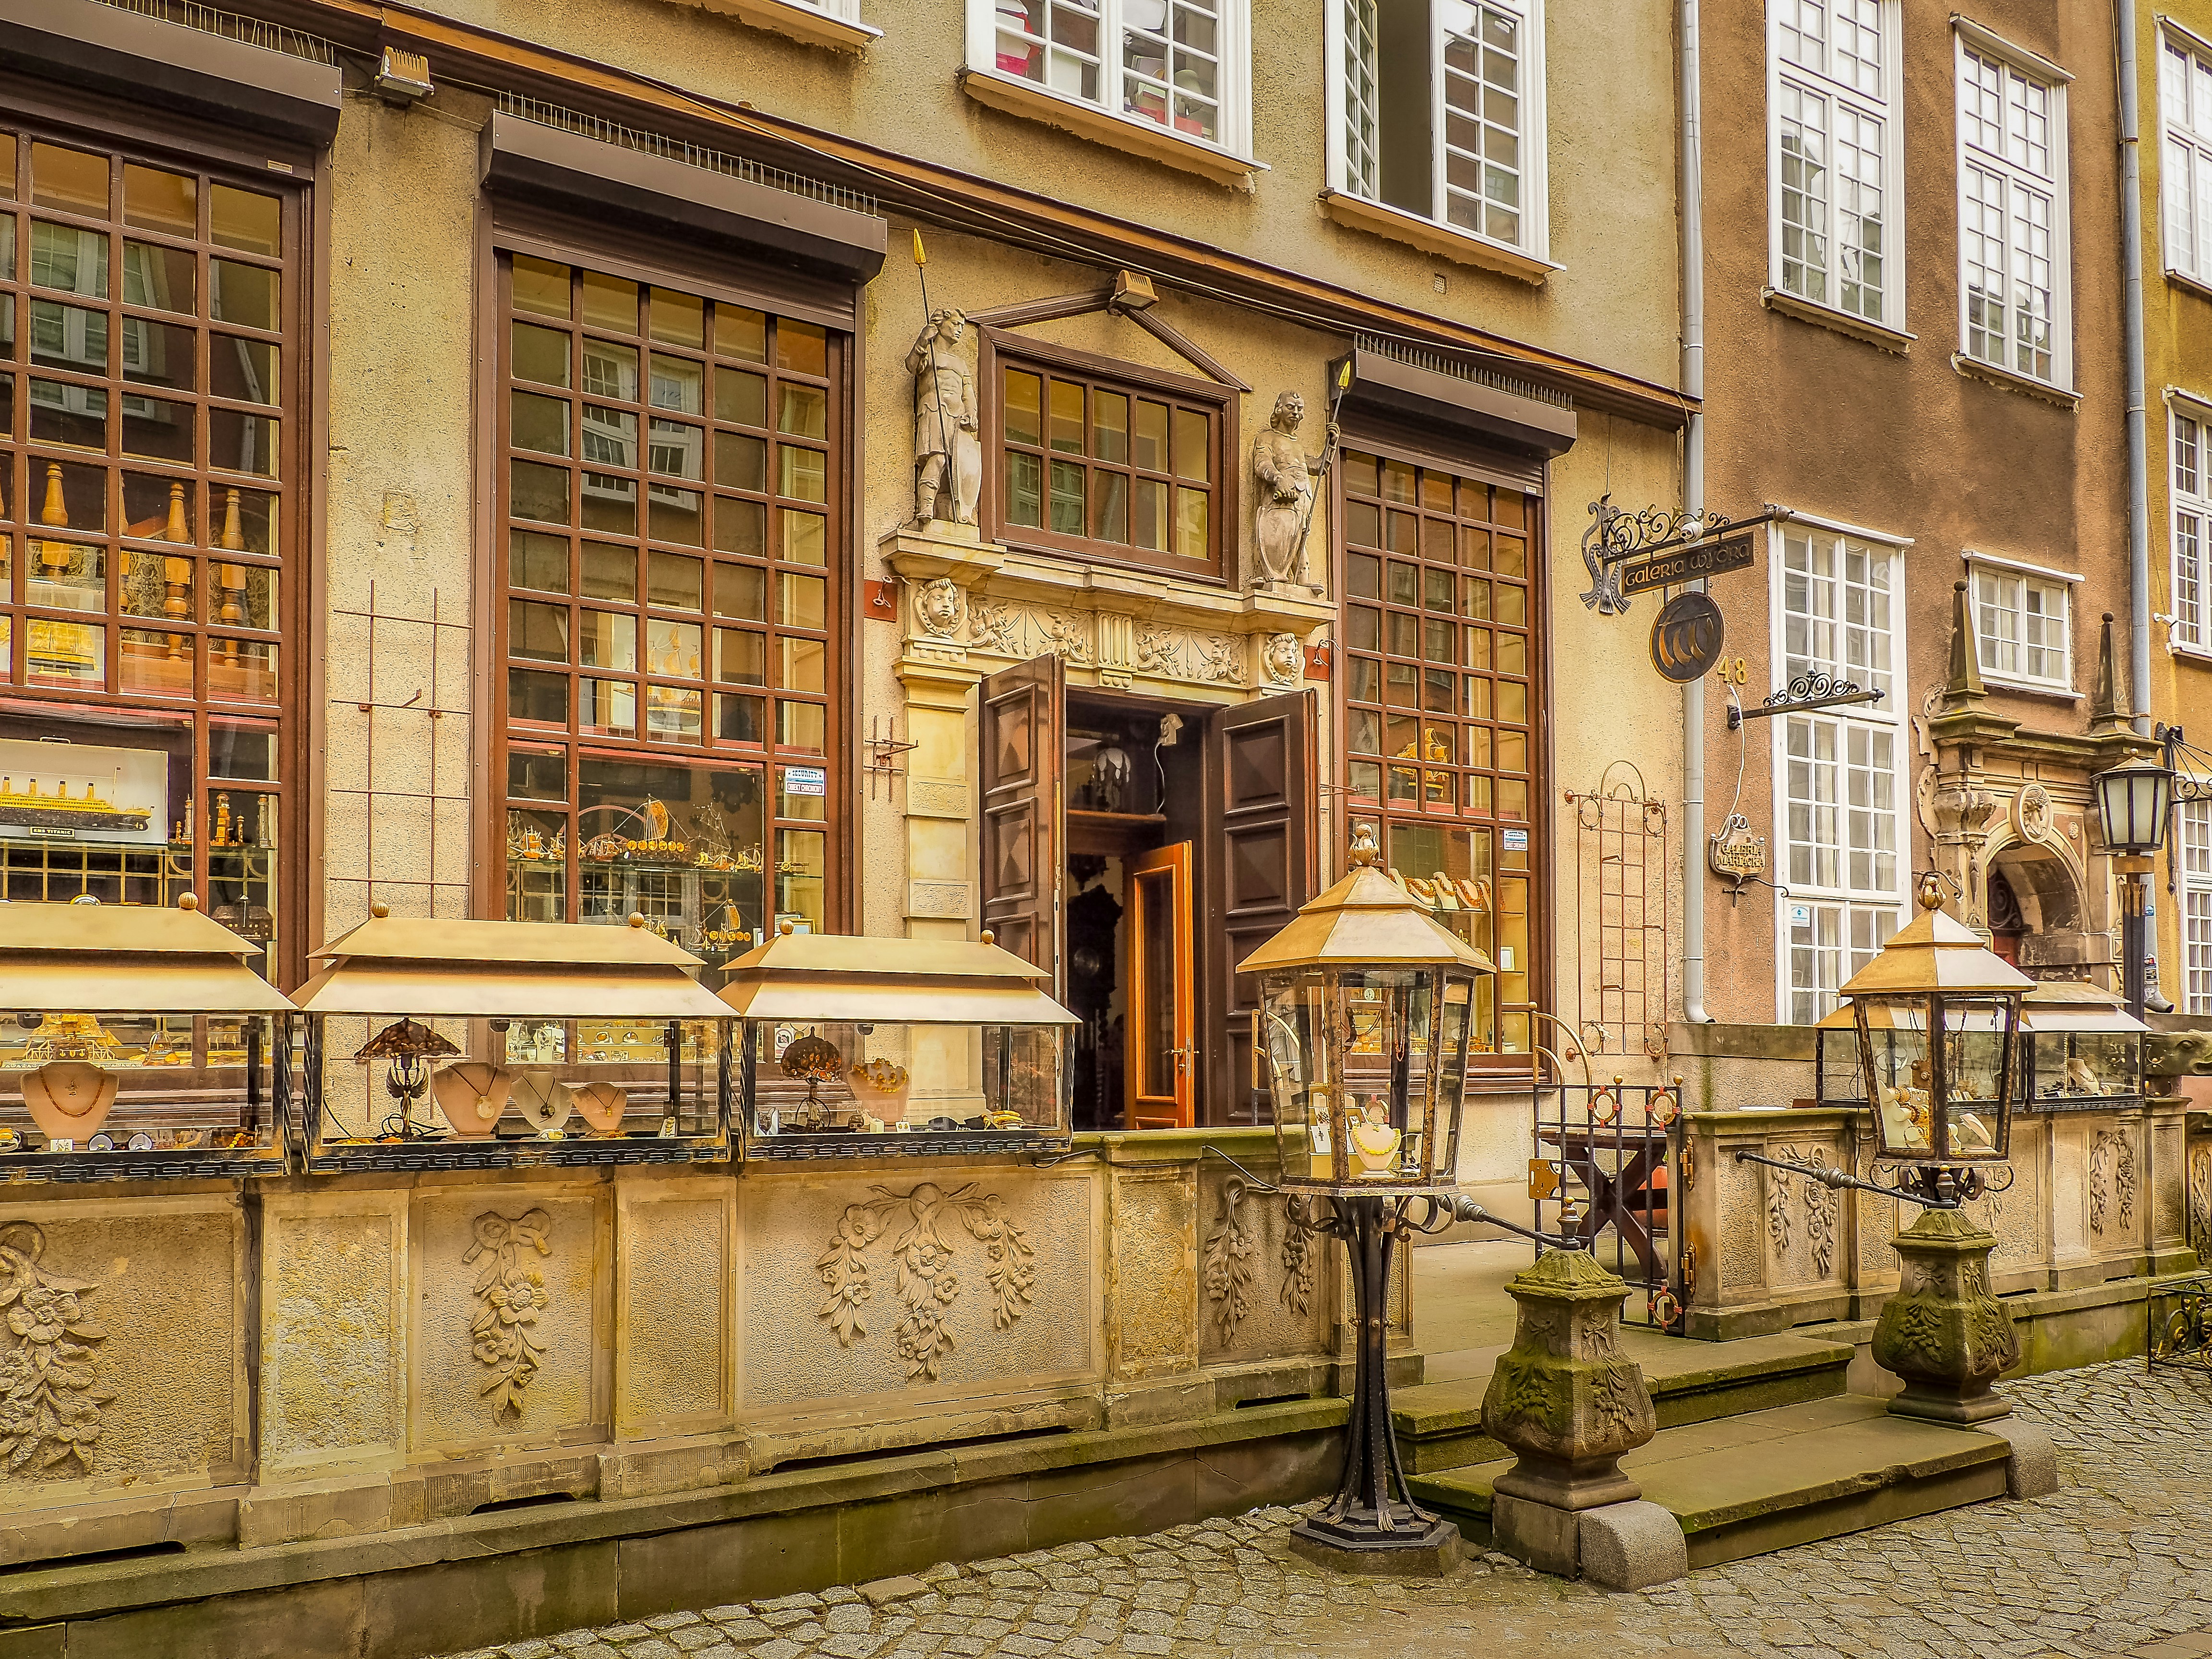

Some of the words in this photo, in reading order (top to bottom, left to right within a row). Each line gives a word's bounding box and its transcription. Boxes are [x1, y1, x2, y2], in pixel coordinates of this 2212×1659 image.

[1717, 656, 1748, 684] 48
[792, 769, 817, 778] SECURITY
[1720, 843, 1762, 856] GALERIA
[1716, 855, 1764, 868] MARIACKA
